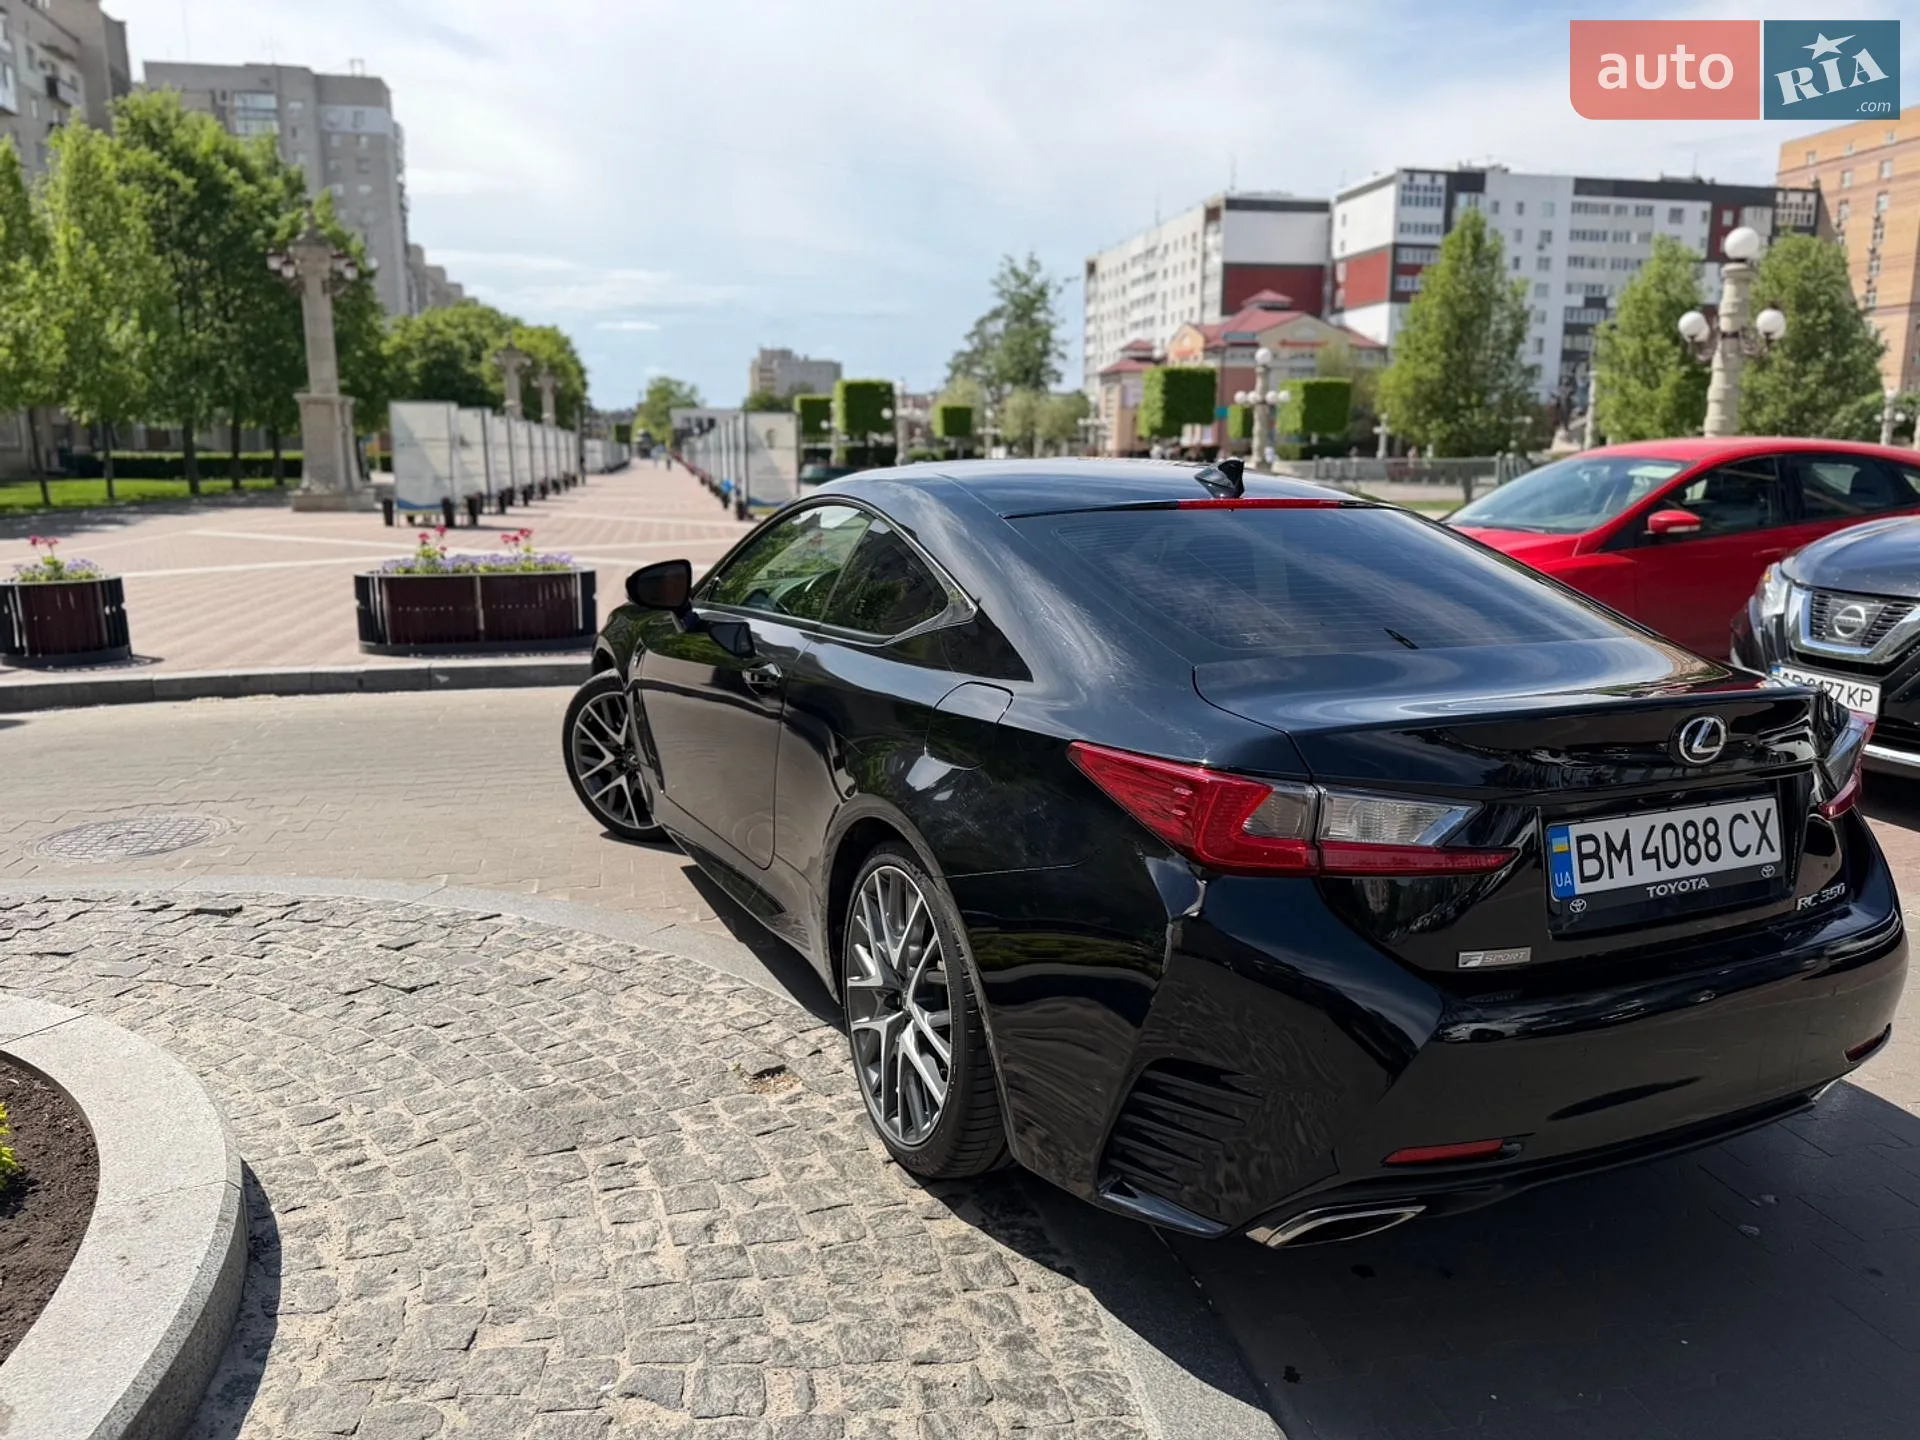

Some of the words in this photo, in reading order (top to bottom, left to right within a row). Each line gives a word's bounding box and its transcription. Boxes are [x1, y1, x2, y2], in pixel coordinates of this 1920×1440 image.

[1846, 685, 1873, 707] KP
[1576, 827, 1634, 884] BM
[1641, 815, 1720, 872] 4088
[1728, 807, 1776, 858] CX
[1554, 871, 1573, 888] UA
[1646, 877, 1709, 898] TOYOTA
[1796, 893, 1818, 911] RC
